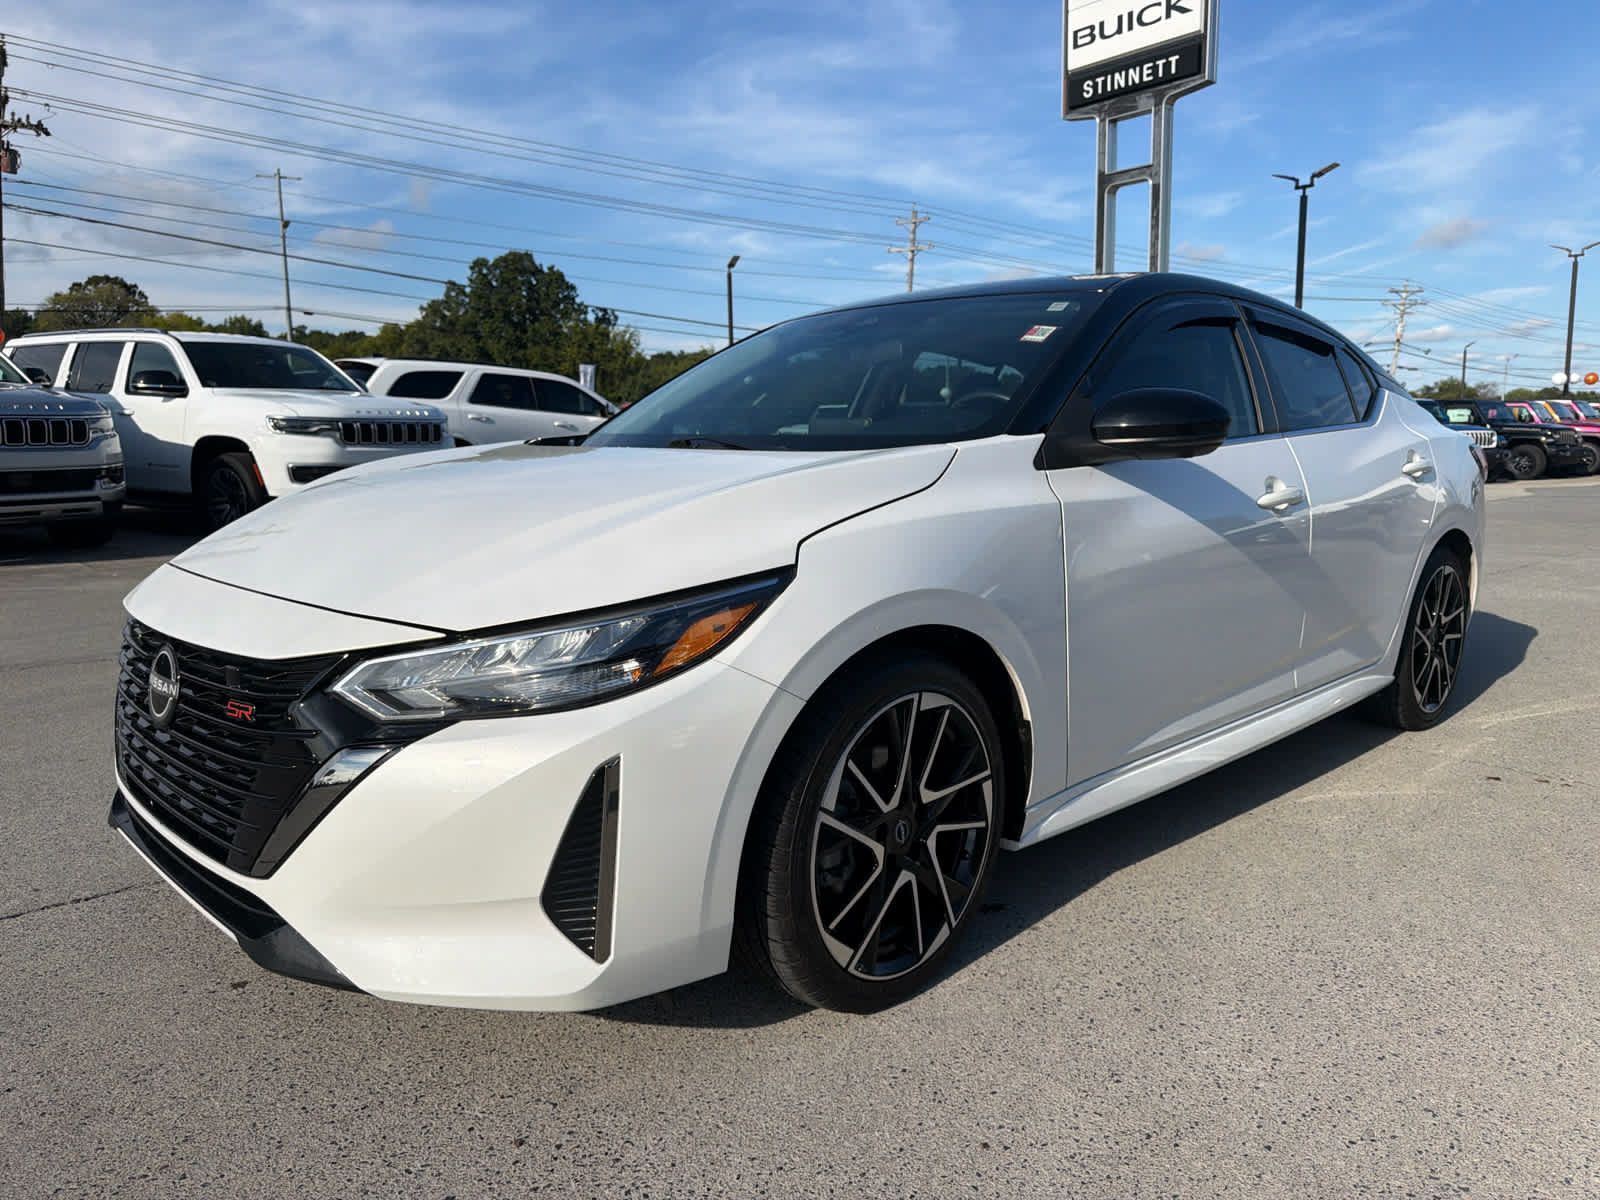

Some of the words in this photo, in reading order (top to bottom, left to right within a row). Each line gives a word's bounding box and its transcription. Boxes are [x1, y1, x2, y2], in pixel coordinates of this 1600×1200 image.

[1072, 0, 1193, 50] BUICK
[1082, 55, 1180, 98] STINNETT
[225, 700, 255, 721] SR
